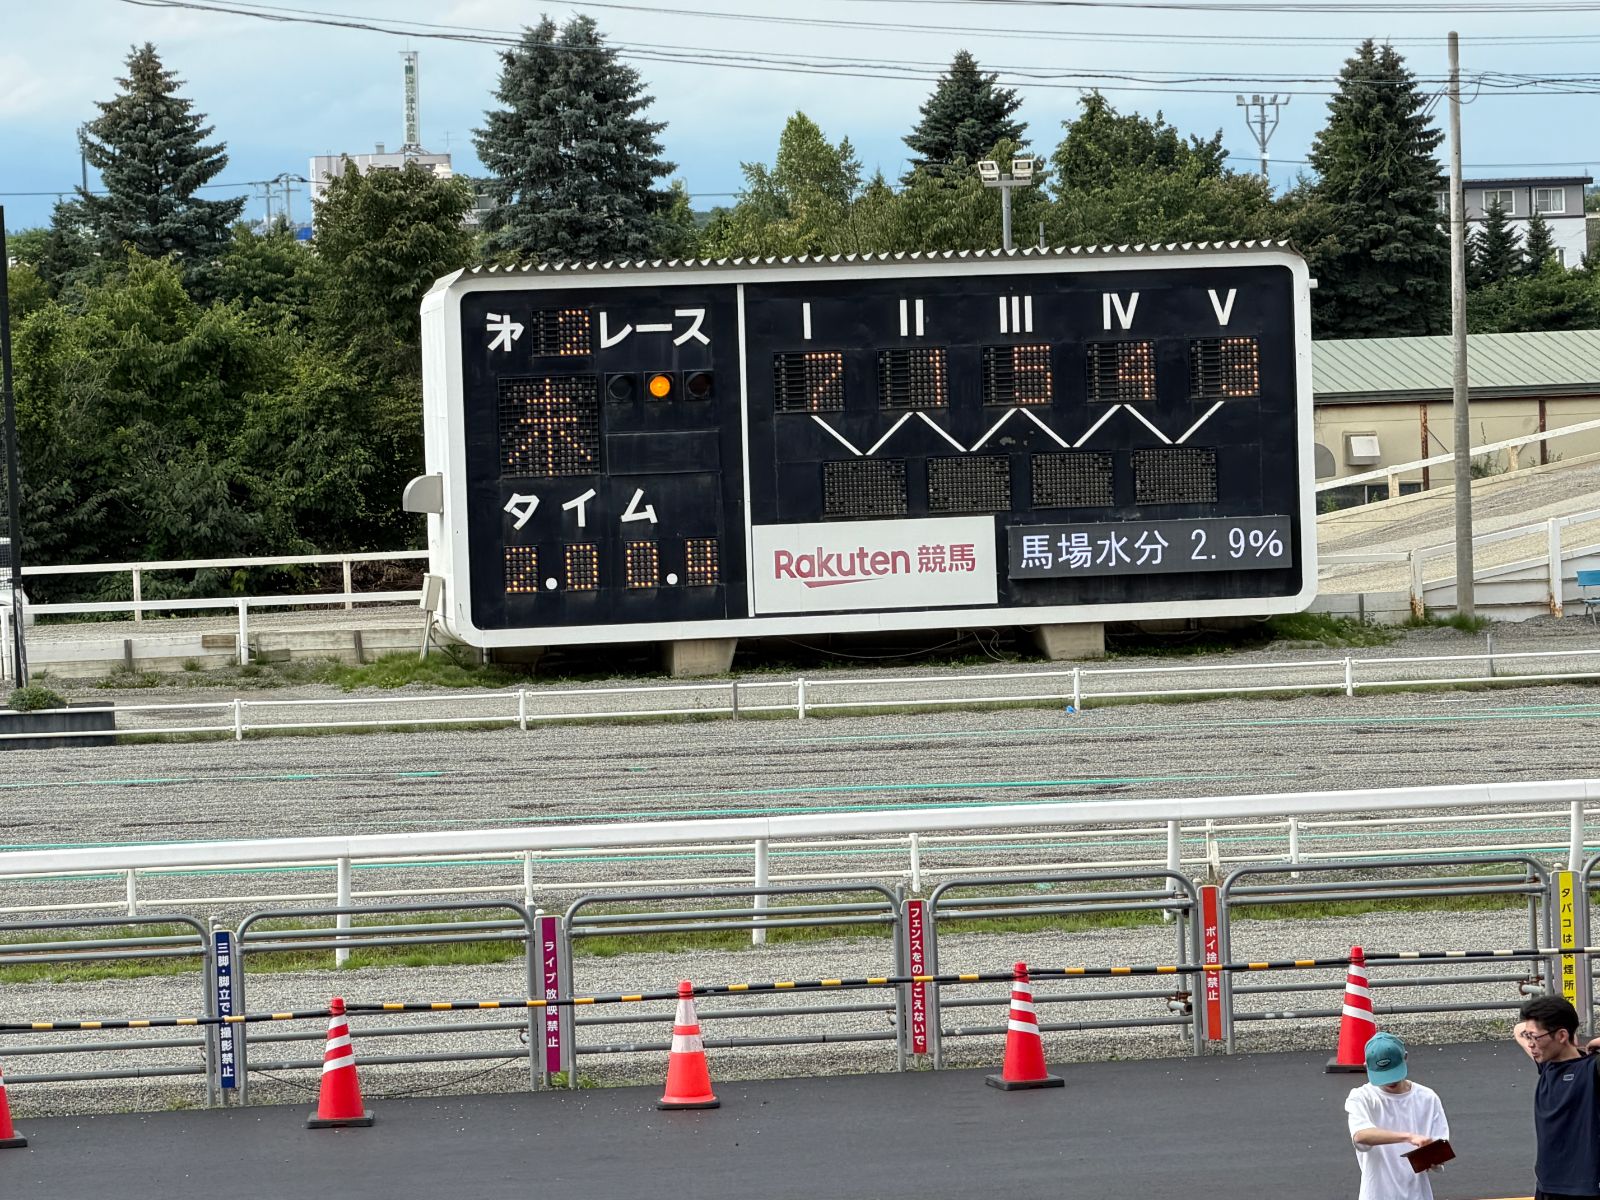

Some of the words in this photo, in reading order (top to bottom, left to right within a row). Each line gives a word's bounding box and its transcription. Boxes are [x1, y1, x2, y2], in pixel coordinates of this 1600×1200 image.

[558, 309, 590, 355] 2
[599, 308, 711, 349] レース
[1102, 292, 1140, 330] IV
[1207, 288, 1238, 326] V
[804, 352, 843, 411] 7
[1013, 345, 1052, 403] 5
[1118, 342, 1156, 399] 4
[1221, 338, 1260, 396] 3
[503, 488, 659, 531] タイム
[774, 546, 911, 580] Rakuten
[917, 543, 976, 574] 競馬
[1020, 530, 1169, 569] 馬場水分
[910, 908, 925, 1046] フェンスをのこえないで
[1205, 925, 1219, 1001] ポイ捨禁止
